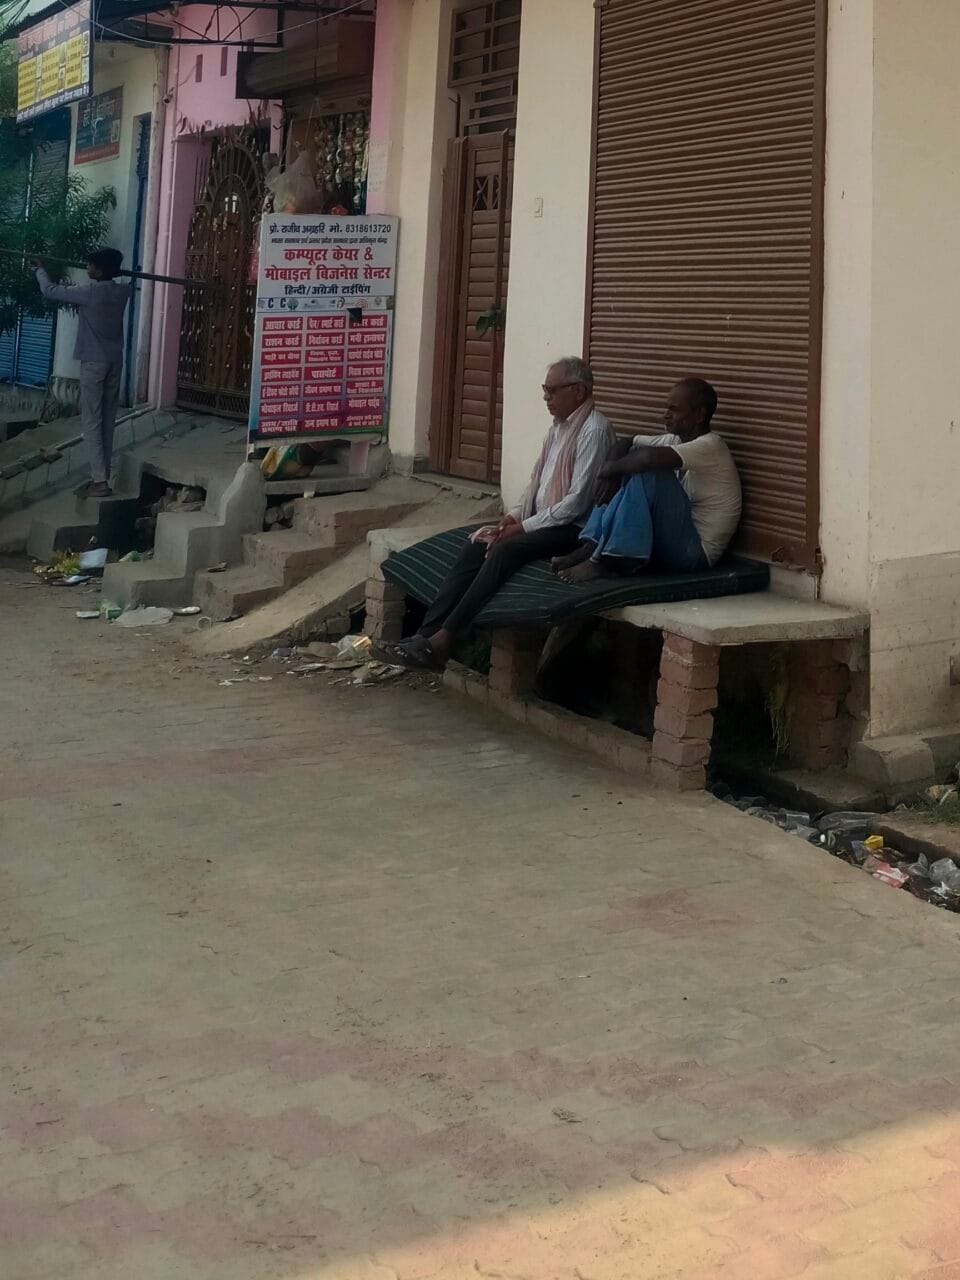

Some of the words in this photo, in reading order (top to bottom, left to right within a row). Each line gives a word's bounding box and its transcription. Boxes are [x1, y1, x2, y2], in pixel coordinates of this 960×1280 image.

[329, 223, 342, 234] मो.
[283, 248, 328, 265] कम्प्यूटर
[332, 246, 360, 261] केयर
[364, 246, 373, 261] &
[264, 265, 312, 282] मोबाइल
[316, 264, 359, 280] बिजनेस
[363, 264, 391, 279] सेन्टर
